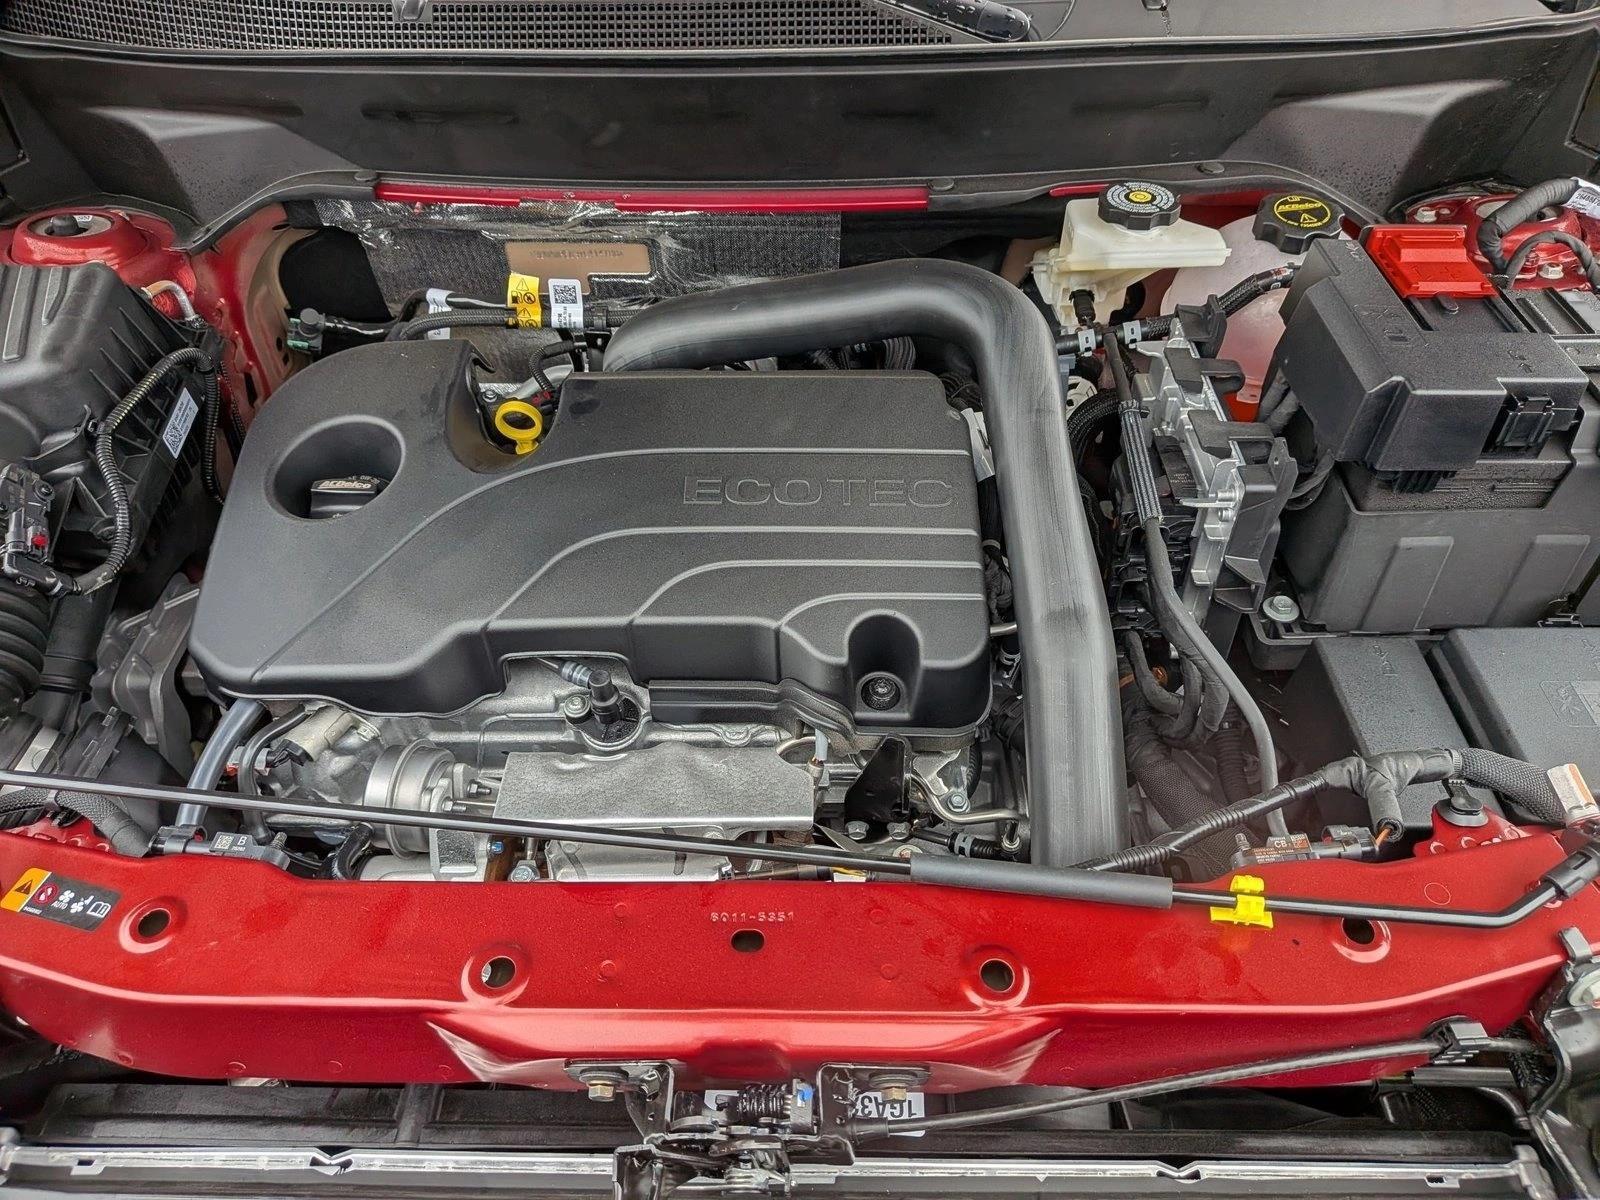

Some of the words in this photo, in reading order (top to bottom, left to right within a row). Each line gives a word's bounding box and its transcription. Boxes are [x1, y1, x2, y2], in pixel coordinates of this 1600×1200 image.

[317, 480, 372, 489] ACDelco
[683, 475, 952, 508] ECOTEC
[237, 835, 247, 846] B
[1274, 840, 1288, 848] CB
[51, 900, 68, 910] AUTO
